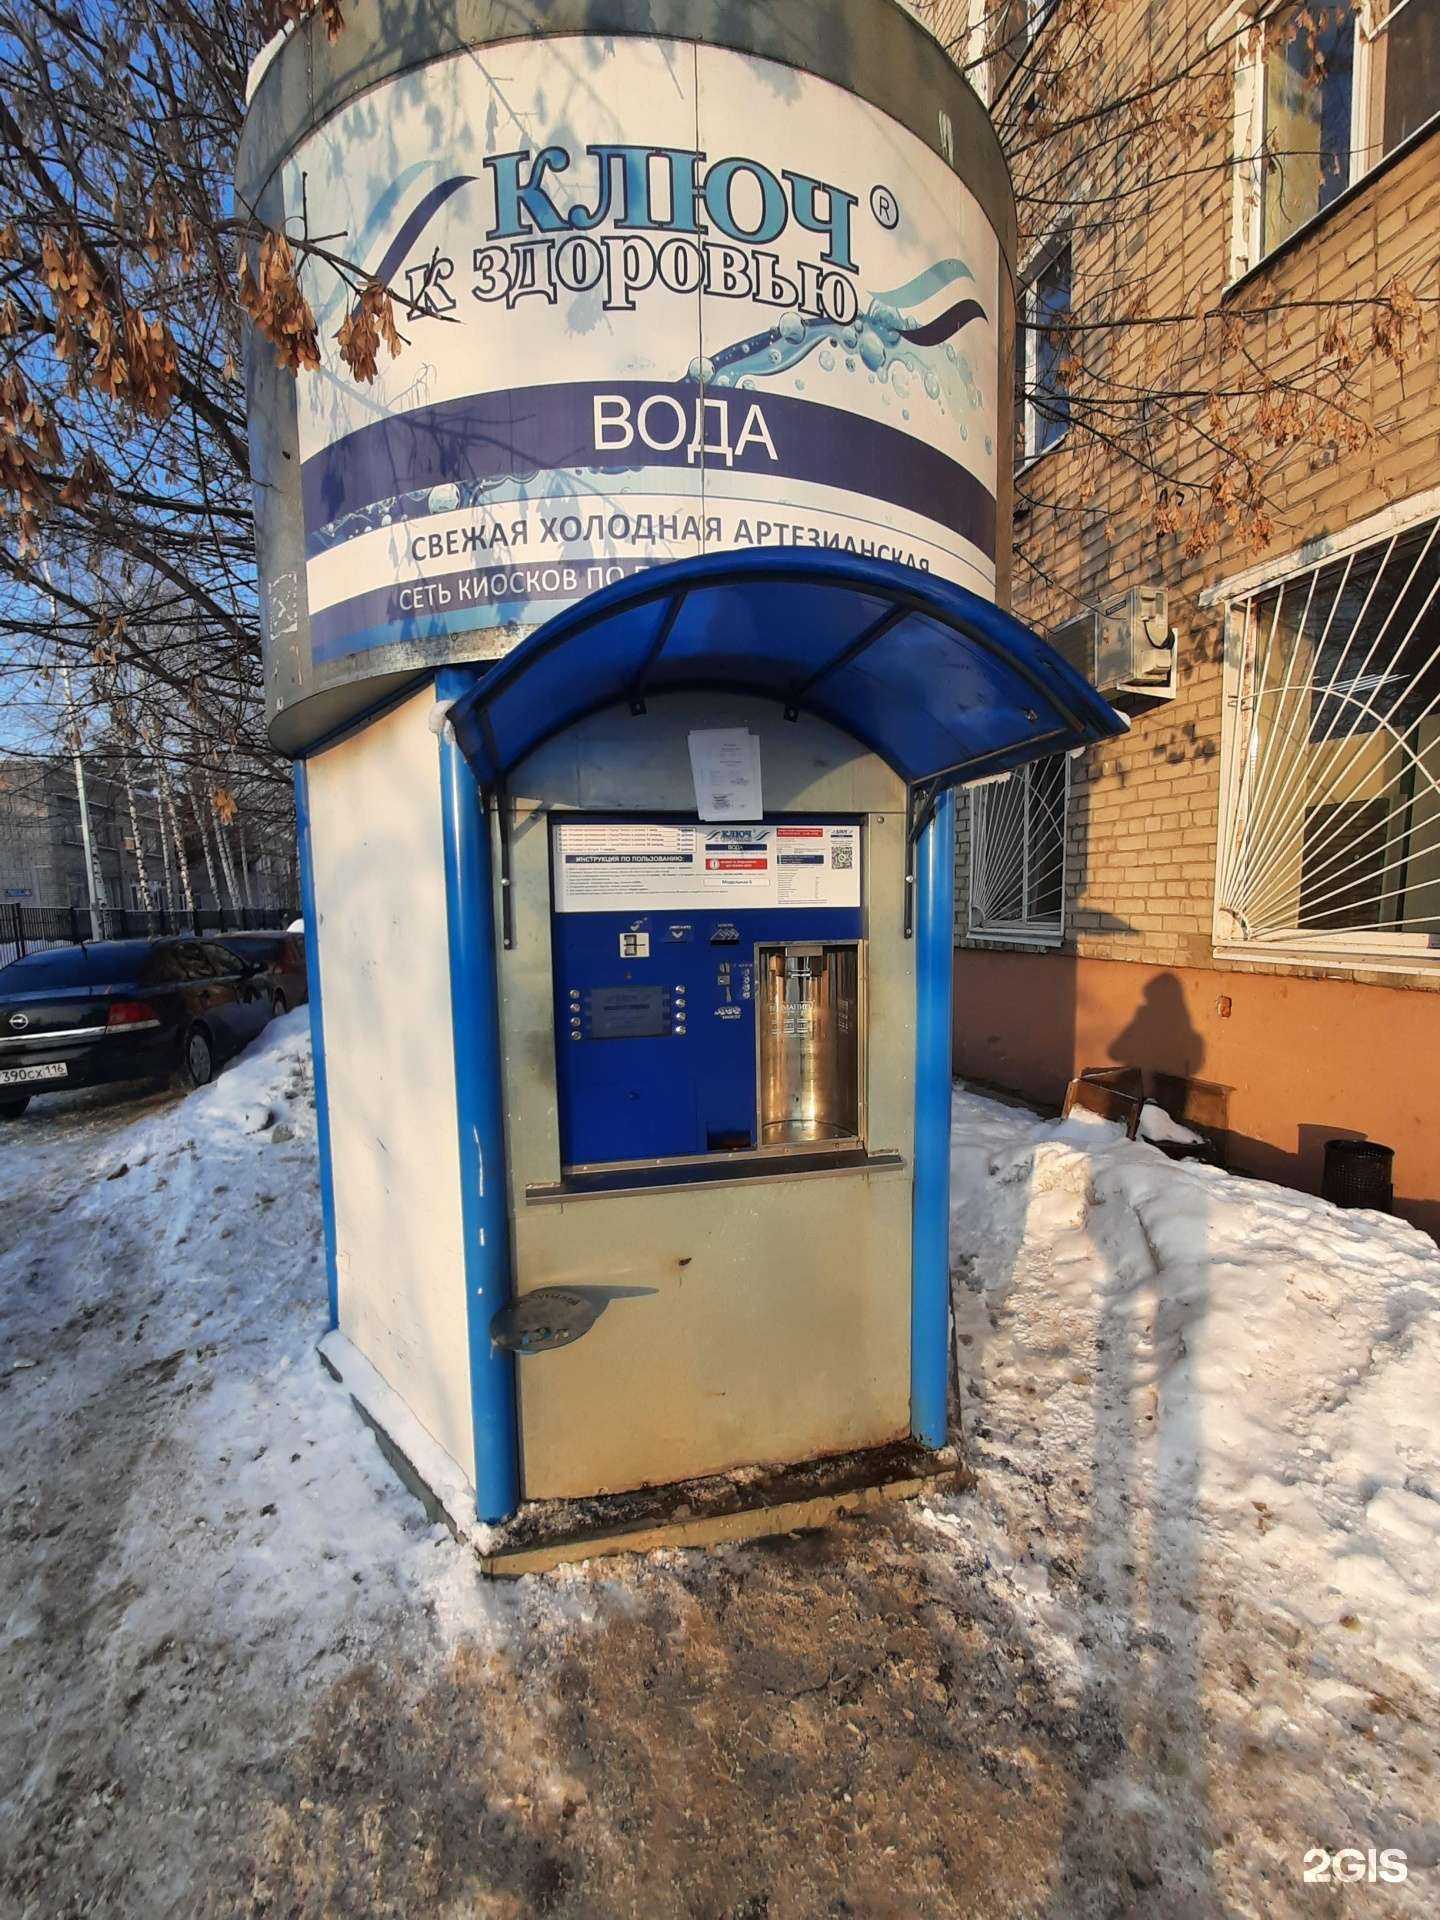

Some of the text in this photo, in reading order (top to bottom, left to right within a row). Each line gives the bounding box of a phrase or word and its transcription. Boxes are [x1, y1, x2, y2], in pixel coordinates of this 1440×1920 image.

[483, 144, 859, 273] КЛЮЧ
[593, 394, 779, 467] ВОДА
[411, 519, 528, 561] СВЕЖАЯ
[540, 514, 722, 545] ХОЛОДНАЯ
[400, 566, 625, 611] СЕТЬ КИОСКОВ ПО
